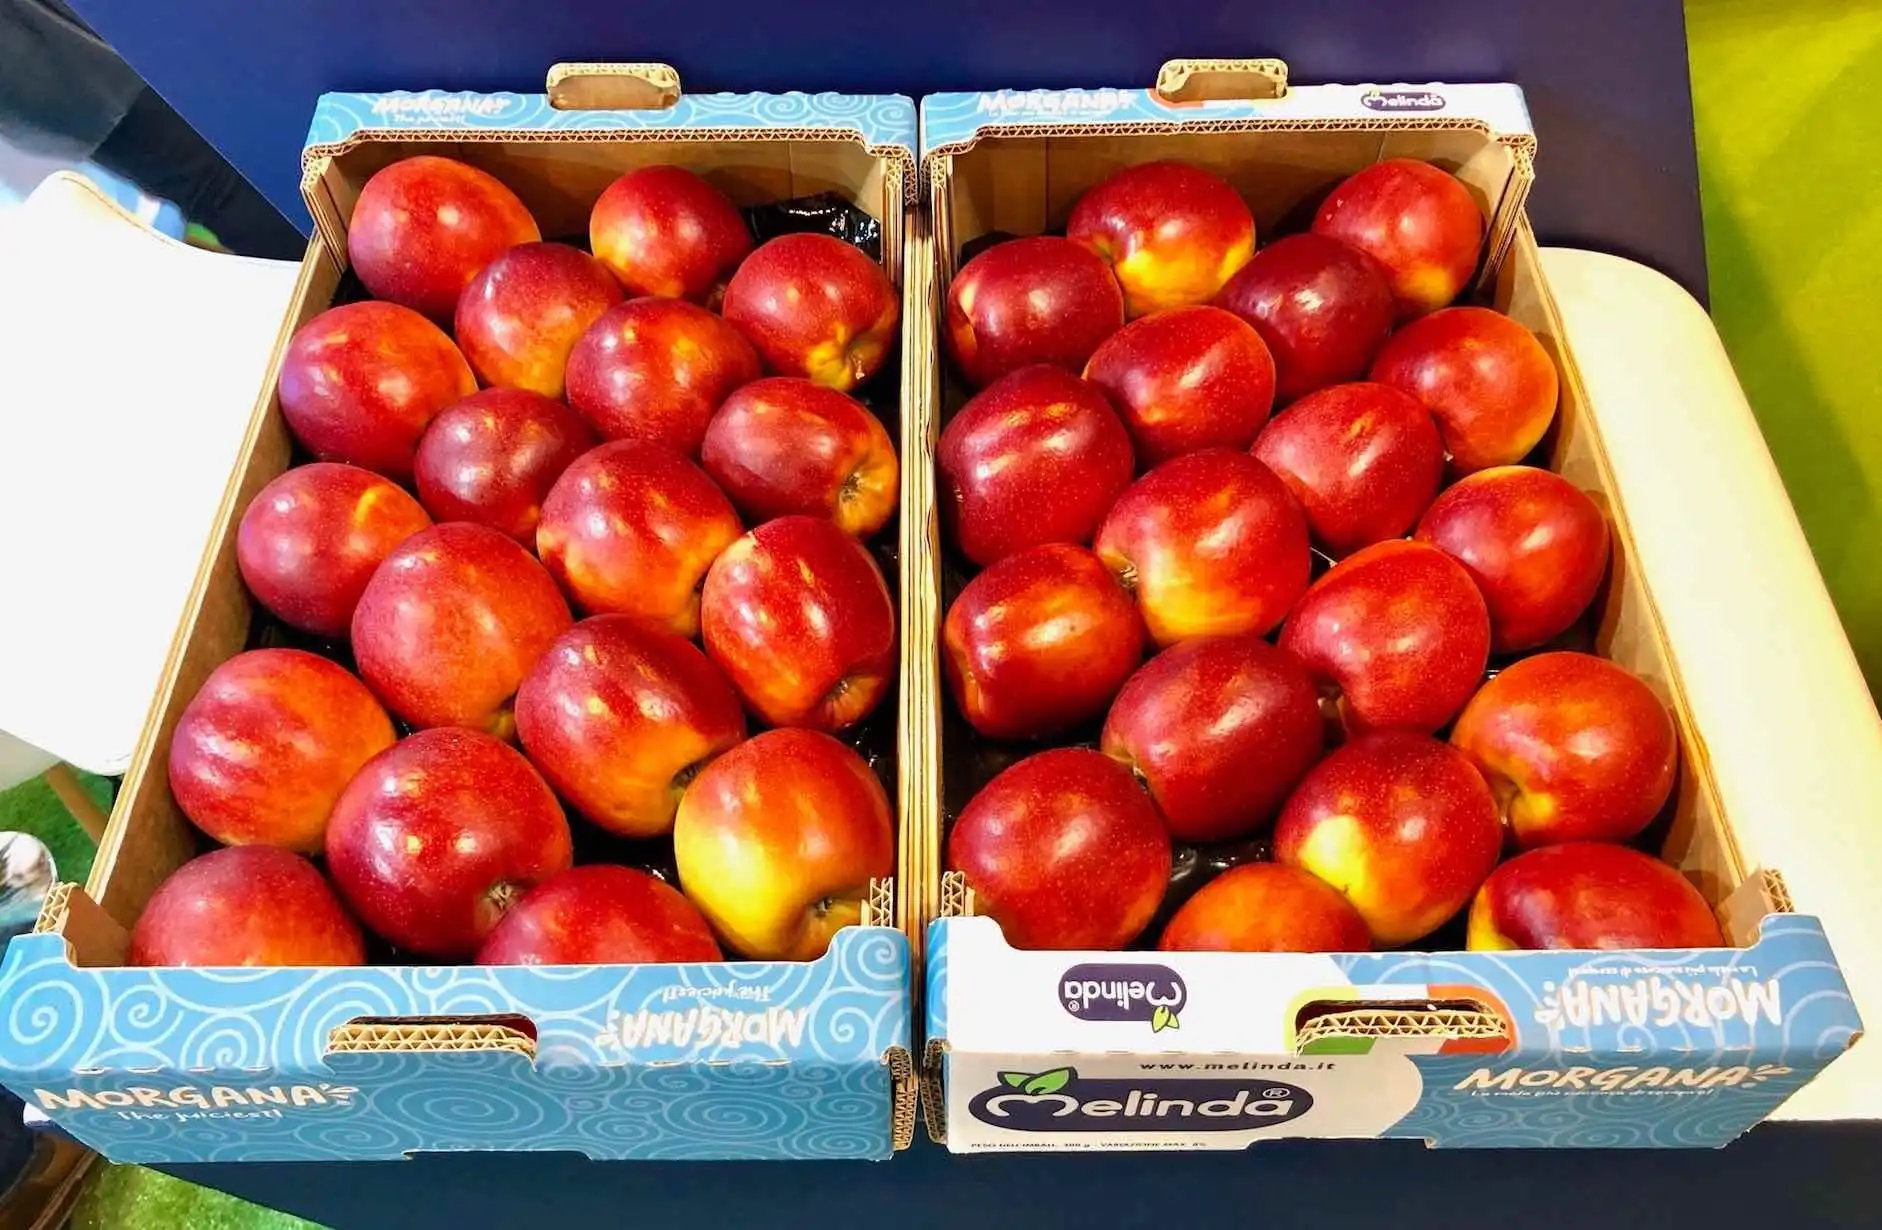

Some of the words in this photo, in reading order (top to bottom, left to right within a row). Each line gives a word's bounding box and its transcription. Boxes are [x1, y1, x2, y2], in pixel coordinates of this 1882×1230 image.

[1560, 976, 1782, 1028] MORGANA
[620, 1006, 809, 1048] MORGANA
[1140, 1061, 1337, 1071] www.melinda.it
[1453, 1065, 1750, 1090] MORGANA
[33, 1085, 328, 1110] MORGANA
[117, 1111, 166, 1122] The
